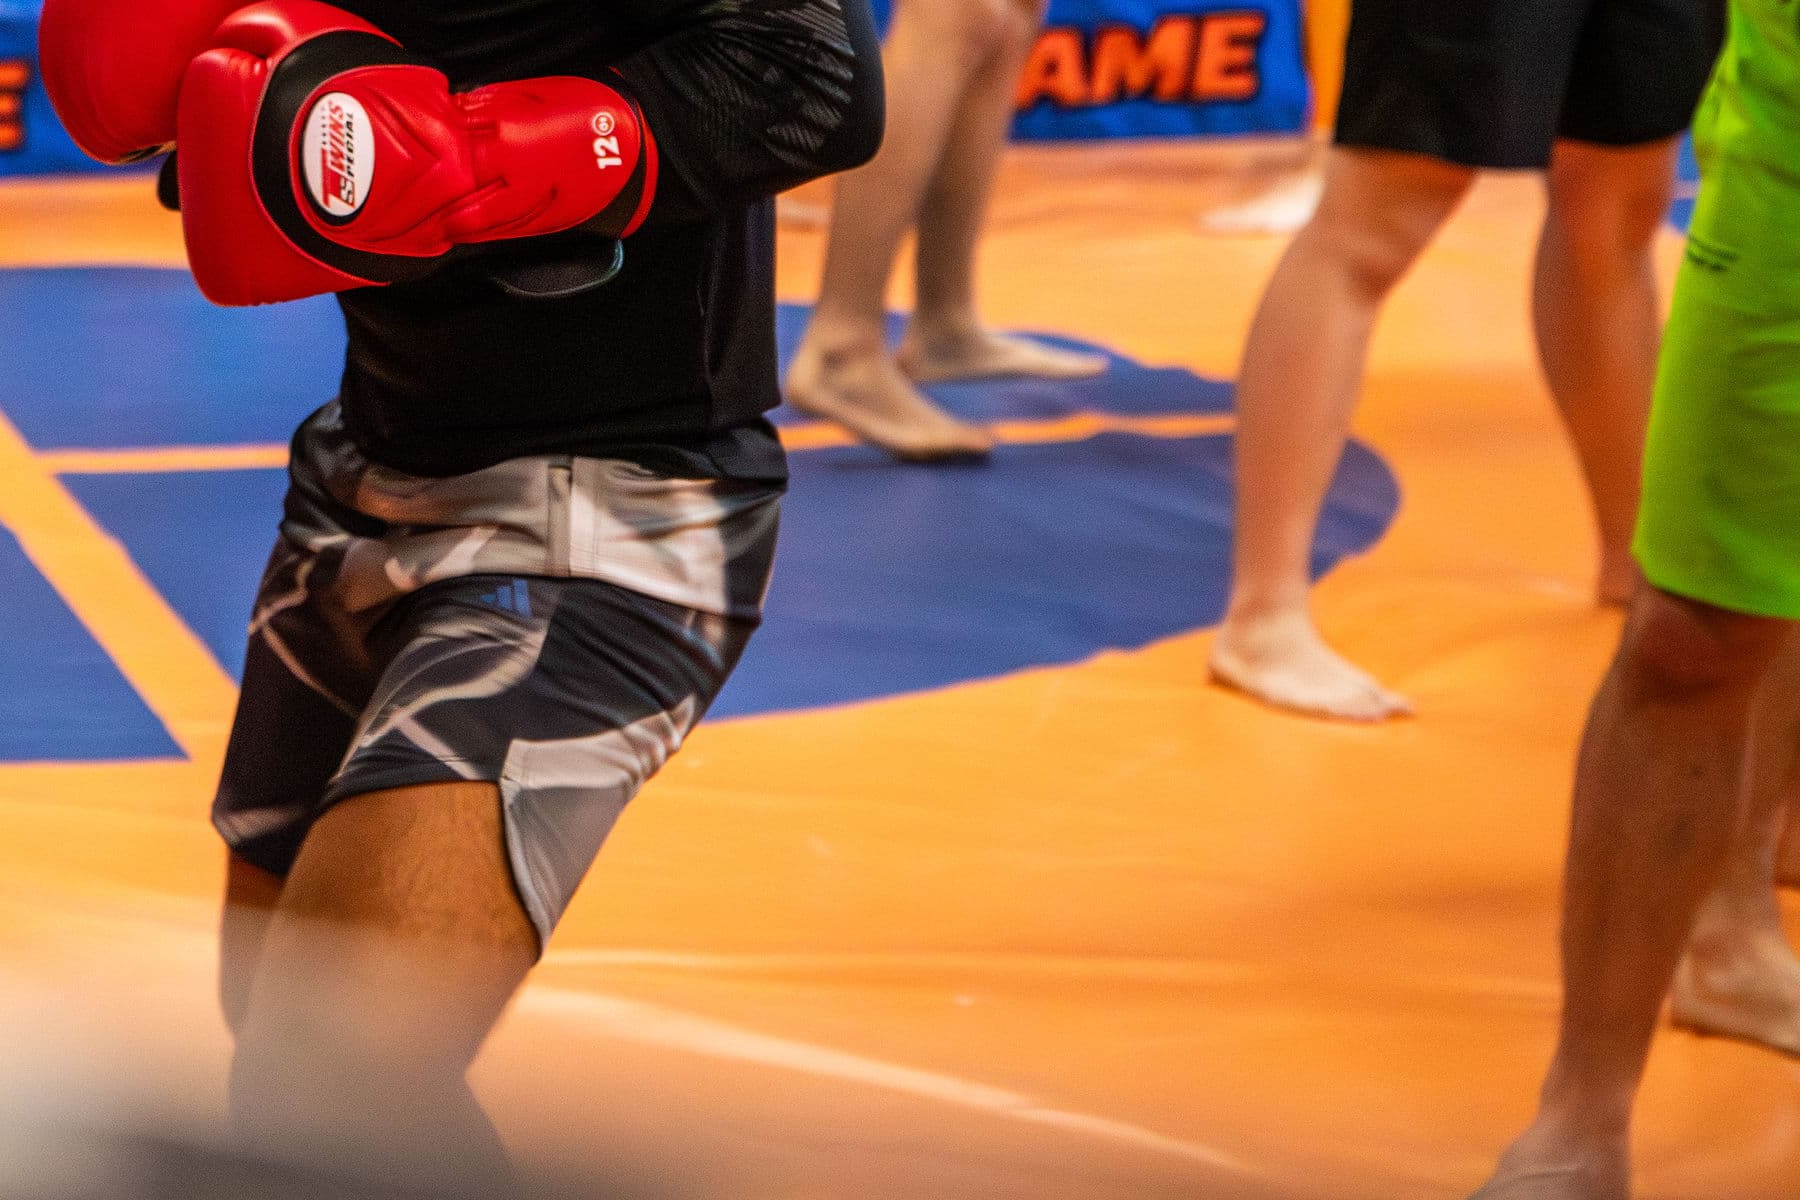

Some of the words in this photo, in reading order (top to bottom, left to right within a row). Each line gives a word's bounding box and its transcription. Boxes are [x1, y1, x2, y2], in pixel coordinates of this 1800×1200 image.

[1011, 7, 1266, 112] AME
[321, 104, 355, 208] TWINS
[340, 112, 355, 208] SPECIAL
[593, 136, 623, 170] 12
